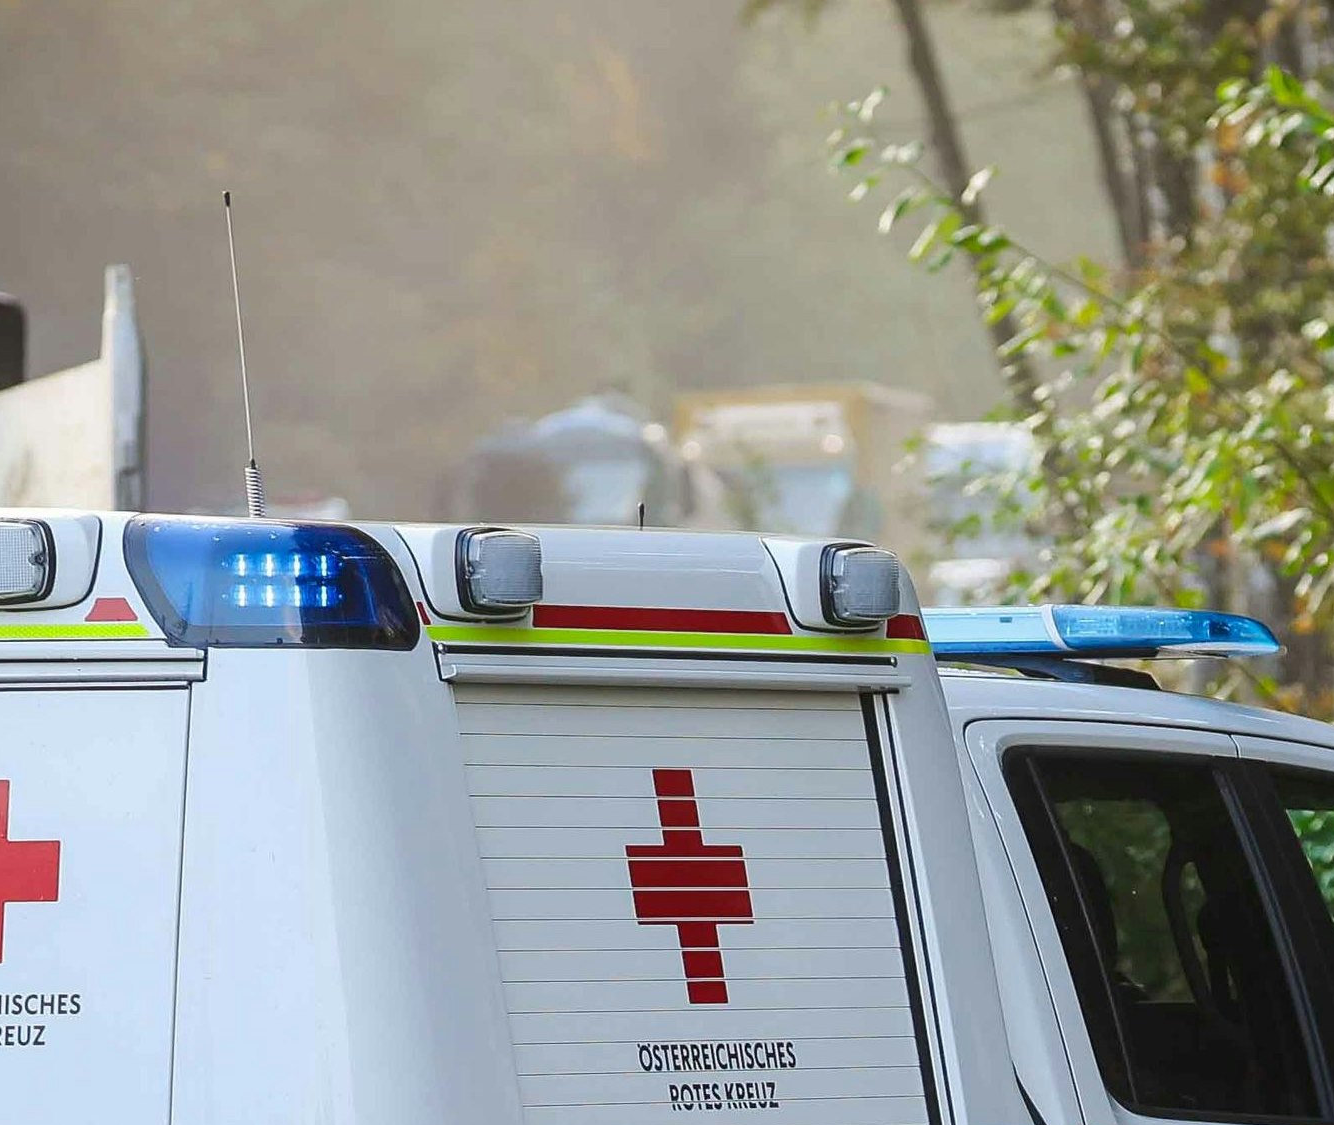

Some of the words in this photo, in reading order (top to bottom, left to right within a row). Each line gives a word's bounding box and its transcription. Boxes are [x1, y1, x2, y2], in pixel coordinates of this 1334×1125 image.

[637, 1041, 797, 1072] ÖSTERREICHISCHES
[669, 1083, 723, 1111] ROTES
[724, 1081, 780, 1109] KREUZ
